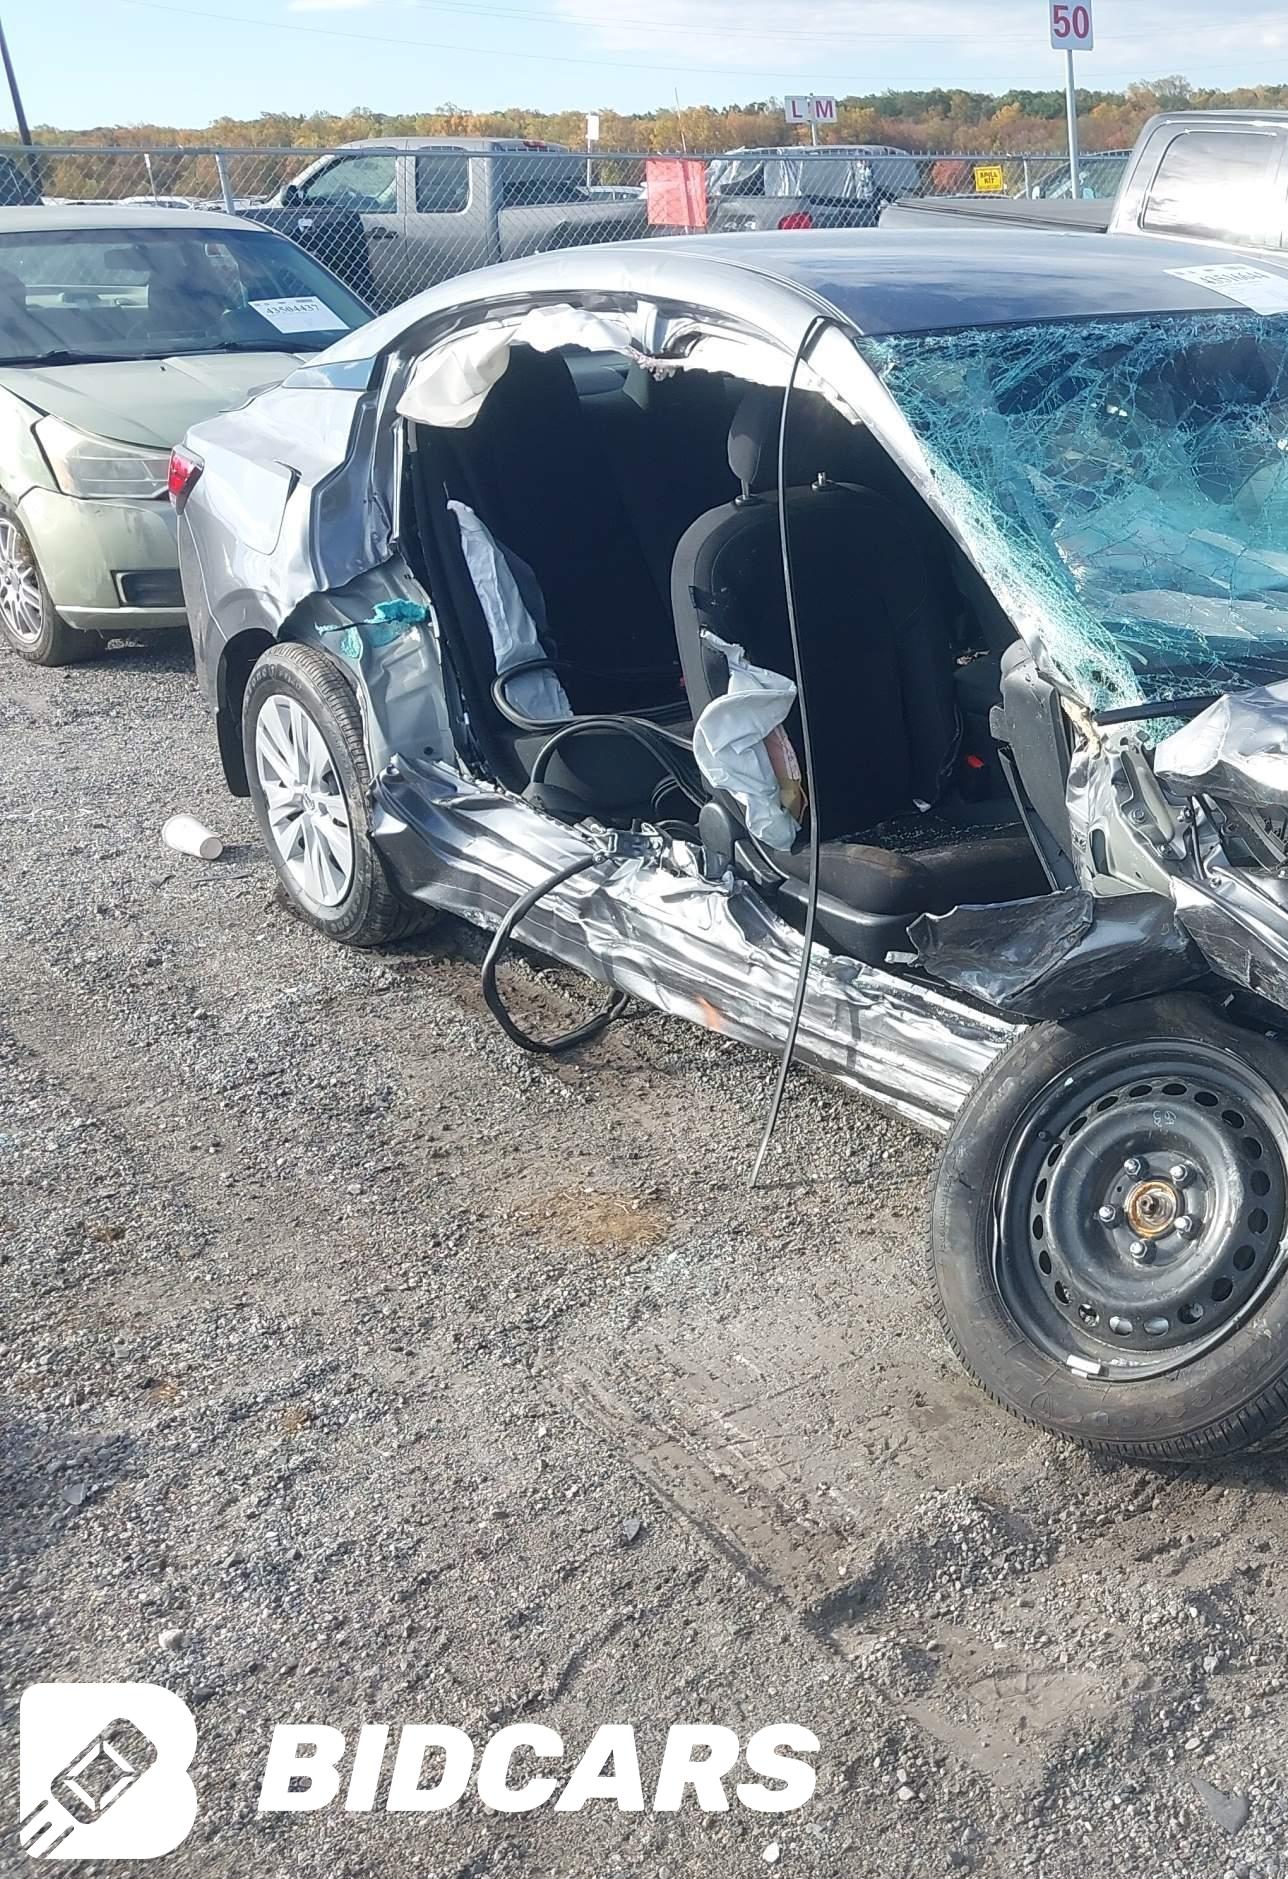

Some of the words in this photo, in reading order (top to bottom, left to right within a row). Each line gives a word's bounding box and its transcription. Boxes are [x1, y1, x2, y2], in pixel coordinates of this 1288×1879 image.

[1053, 4, 1089, 39] 50
[792, 100, 803, 118] L
[815, 100, 833, 118] M
